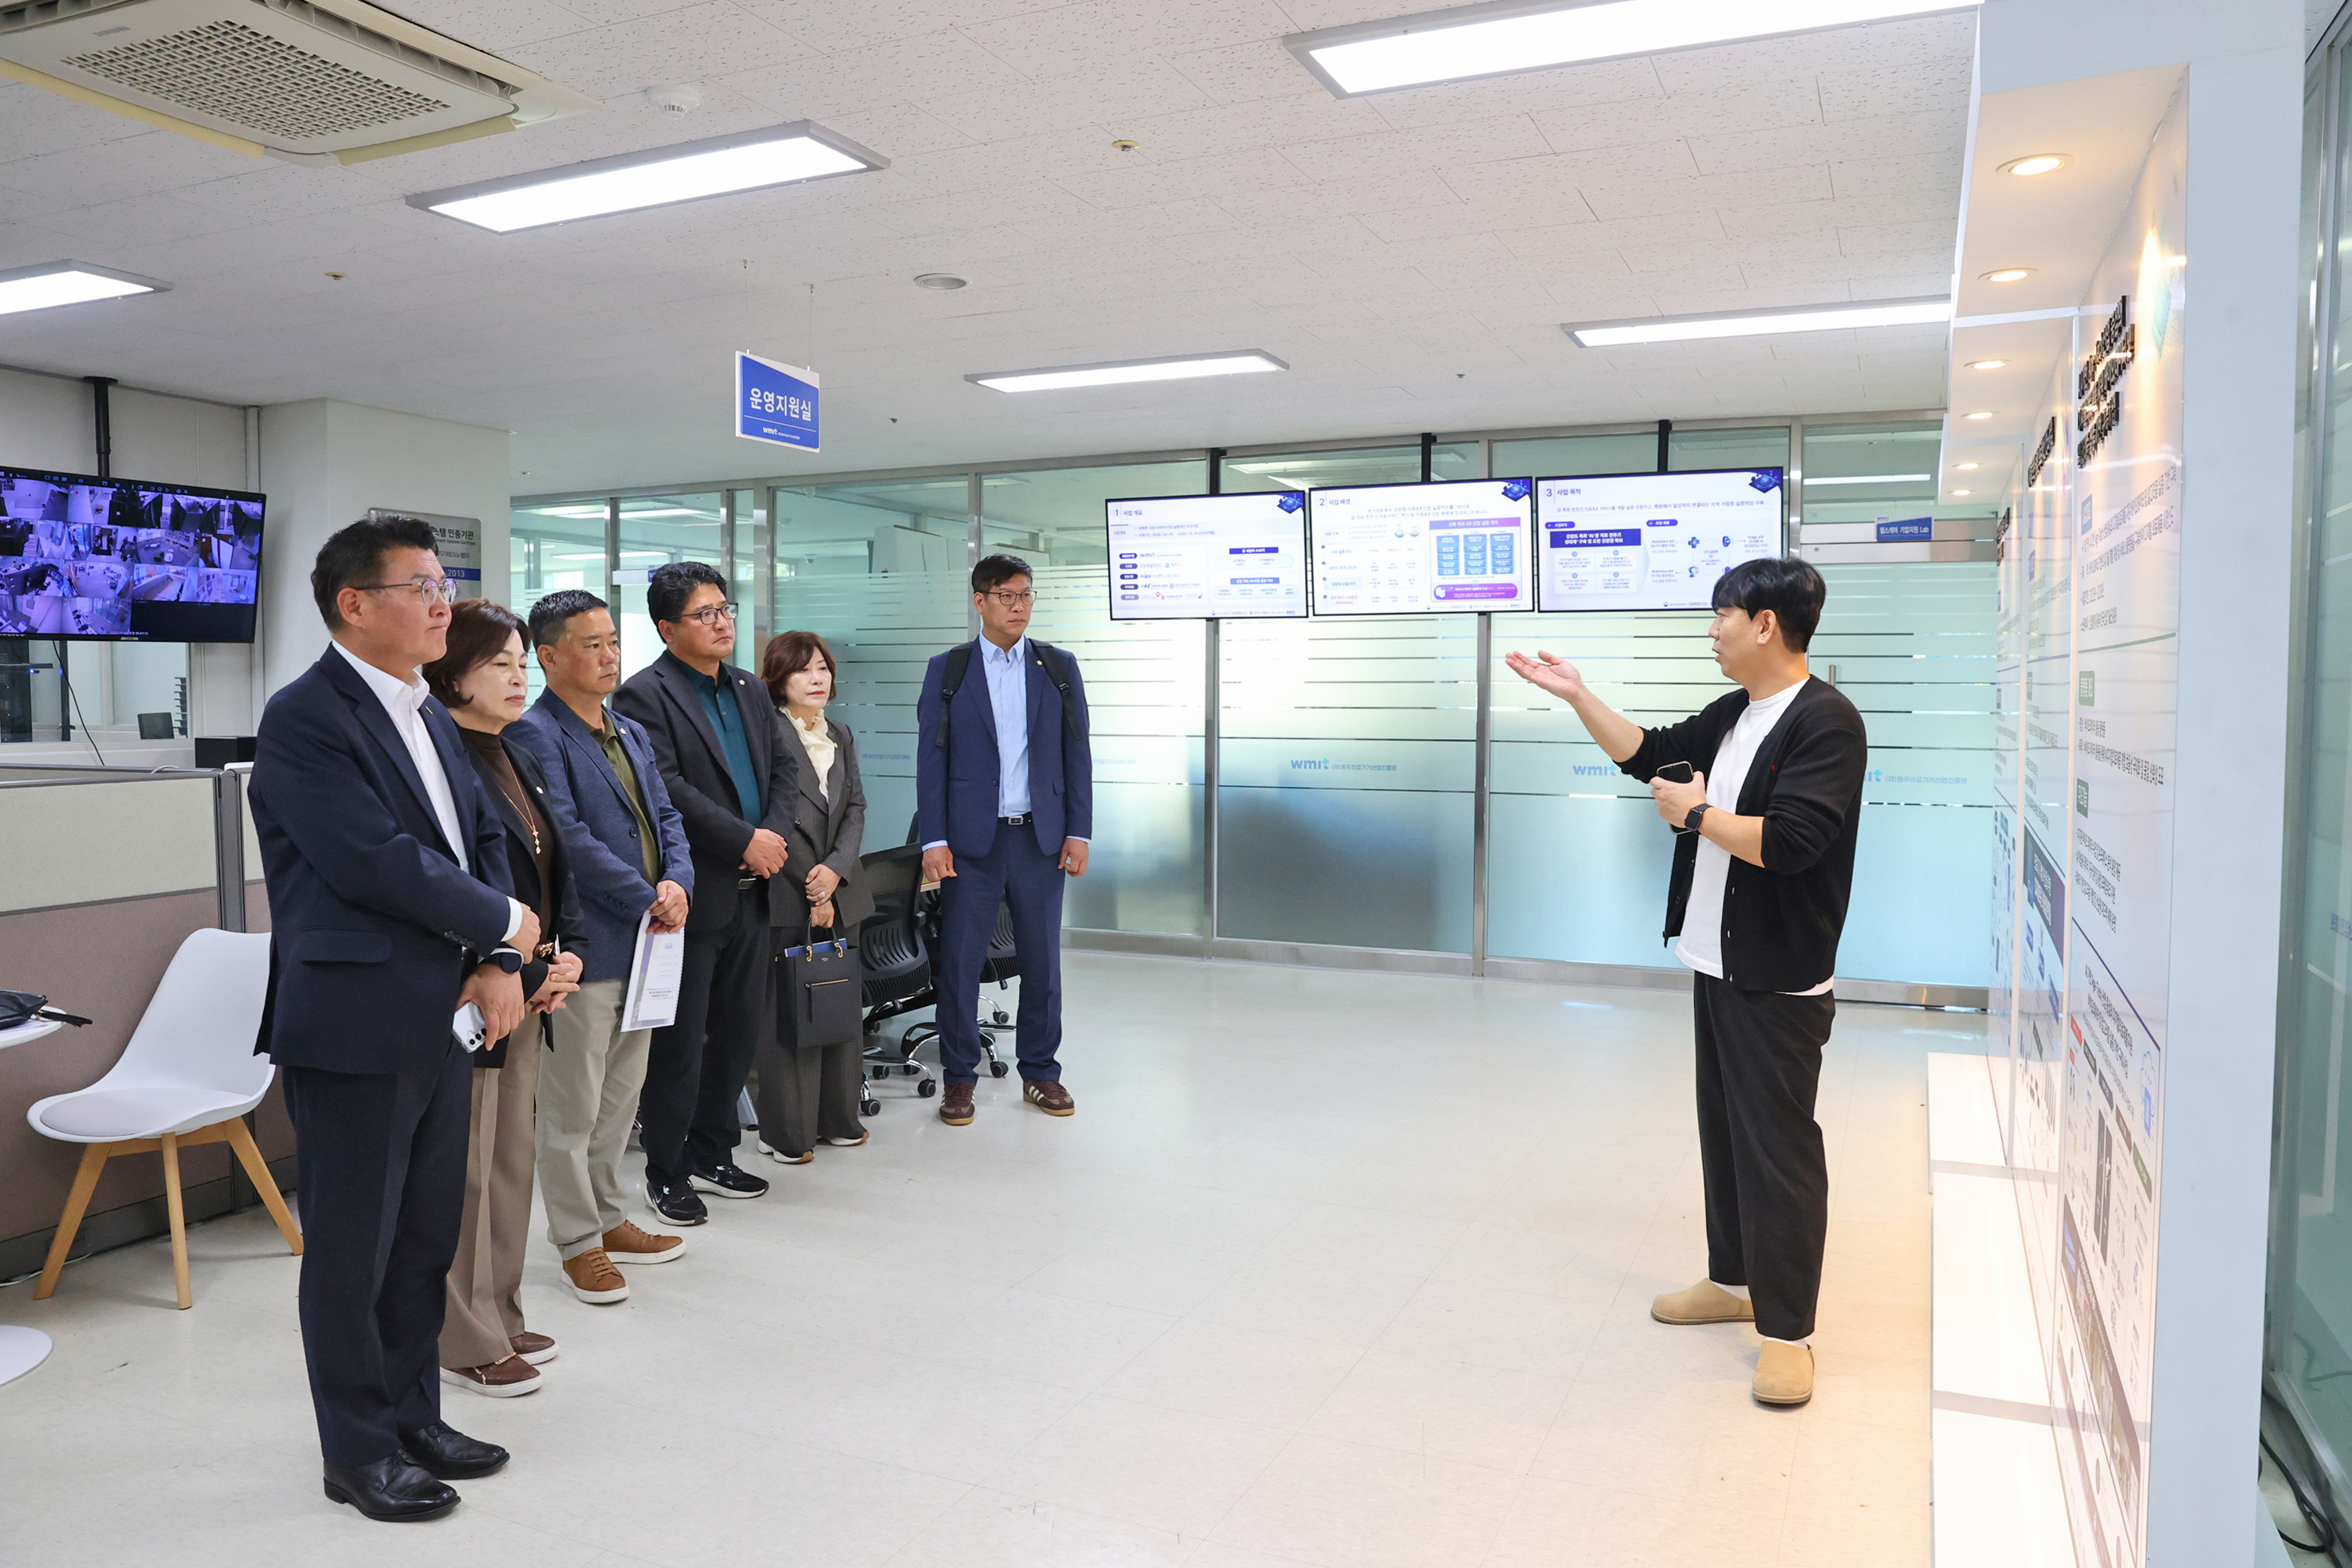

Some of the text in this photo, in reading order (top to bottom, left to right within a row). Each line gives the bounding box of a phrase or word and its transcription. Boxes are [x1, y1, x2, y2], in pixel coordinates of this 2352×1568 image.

[749, 387, 812, 422] 운영지원실
[447, 529, 474, 540] 인증기관
[1291, 758, 1329, 769] wmit
[1572, 764, 1617, 776] wmit
